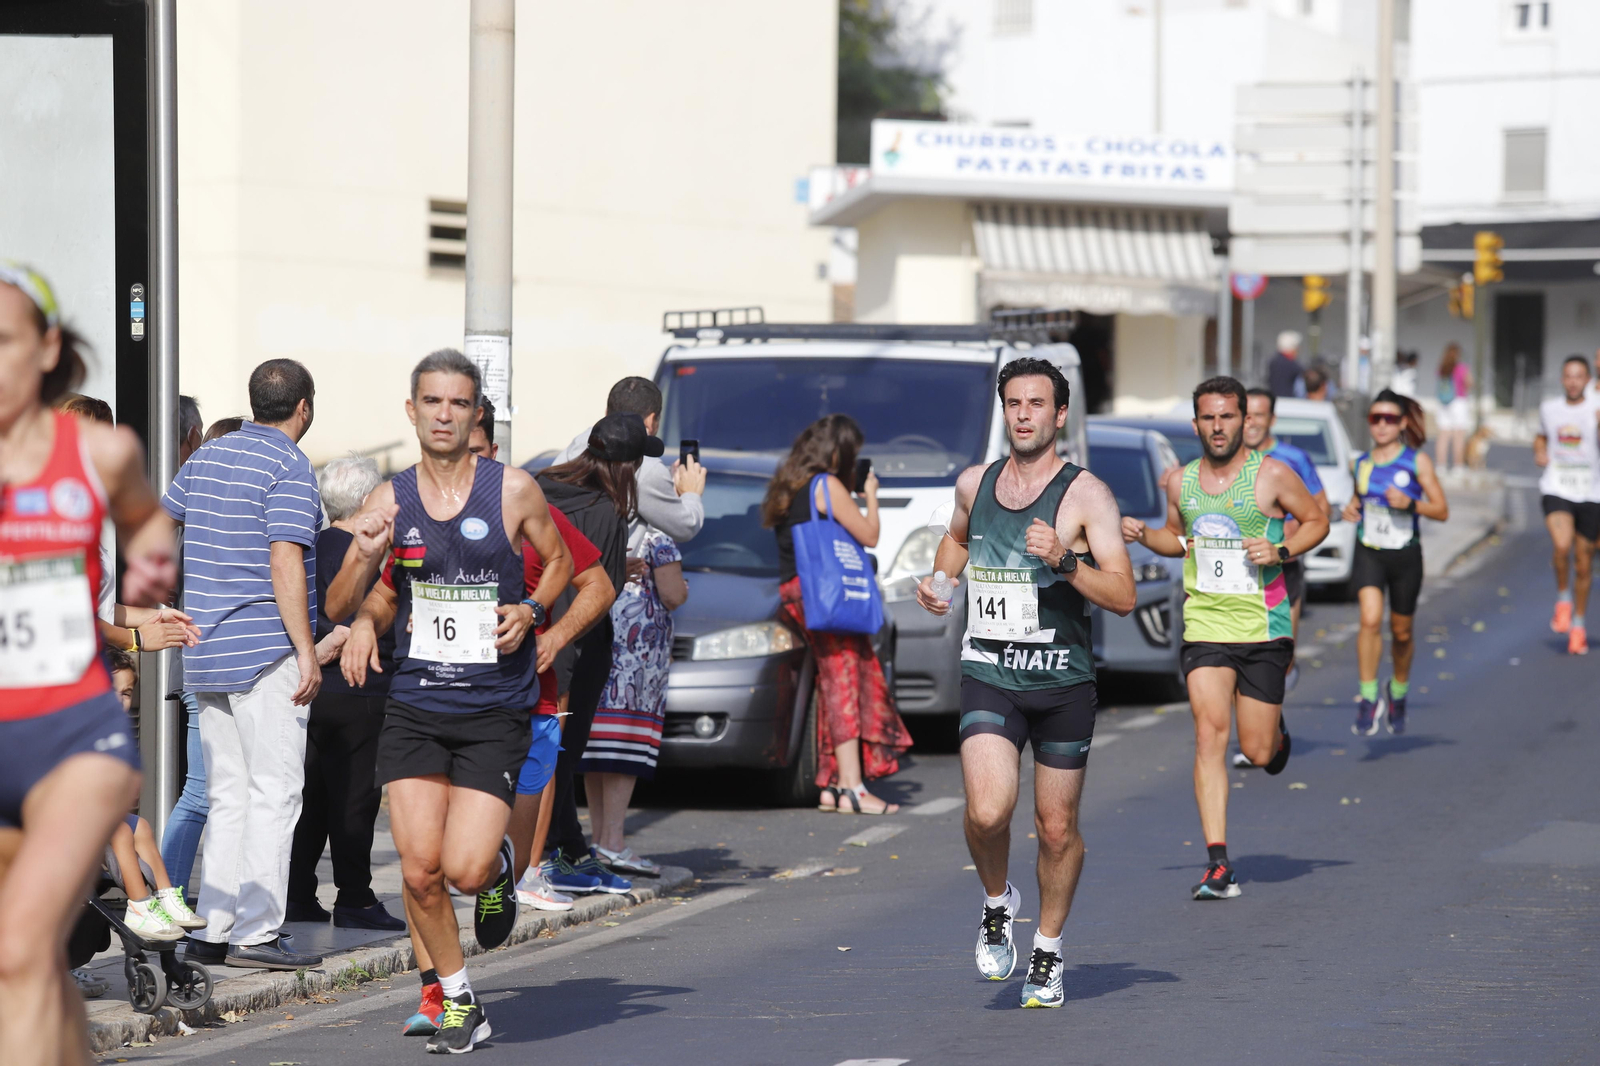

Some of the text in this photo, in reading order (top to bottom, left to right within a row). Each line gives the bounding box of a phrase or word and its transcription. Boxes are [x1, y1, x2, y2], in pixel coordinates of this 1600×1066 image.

[917, 130, 1057, 152] CHURROS
[957, 156, 1207, 181] PATATAS FRITAS
[1205, 539, 1225, 549] VUELTA
[1226, 540, 1232, 549] A
[976, 570, 995, 582] VUELTA
[996, 571, 1003, 582] A
[1004, 571, 1031, 582] HUELVA
[1214, 560, 1223, 578] 8
[425, 587, 451, 601] VUELTA
[452, 589, 460, 601] A
[460, 589, 491, 600] HUELVA
[977, 596, 1006, 620] 141
[433, 616, 456, 641] 16
[1003, 643, 1070, 670] ÉNATE
